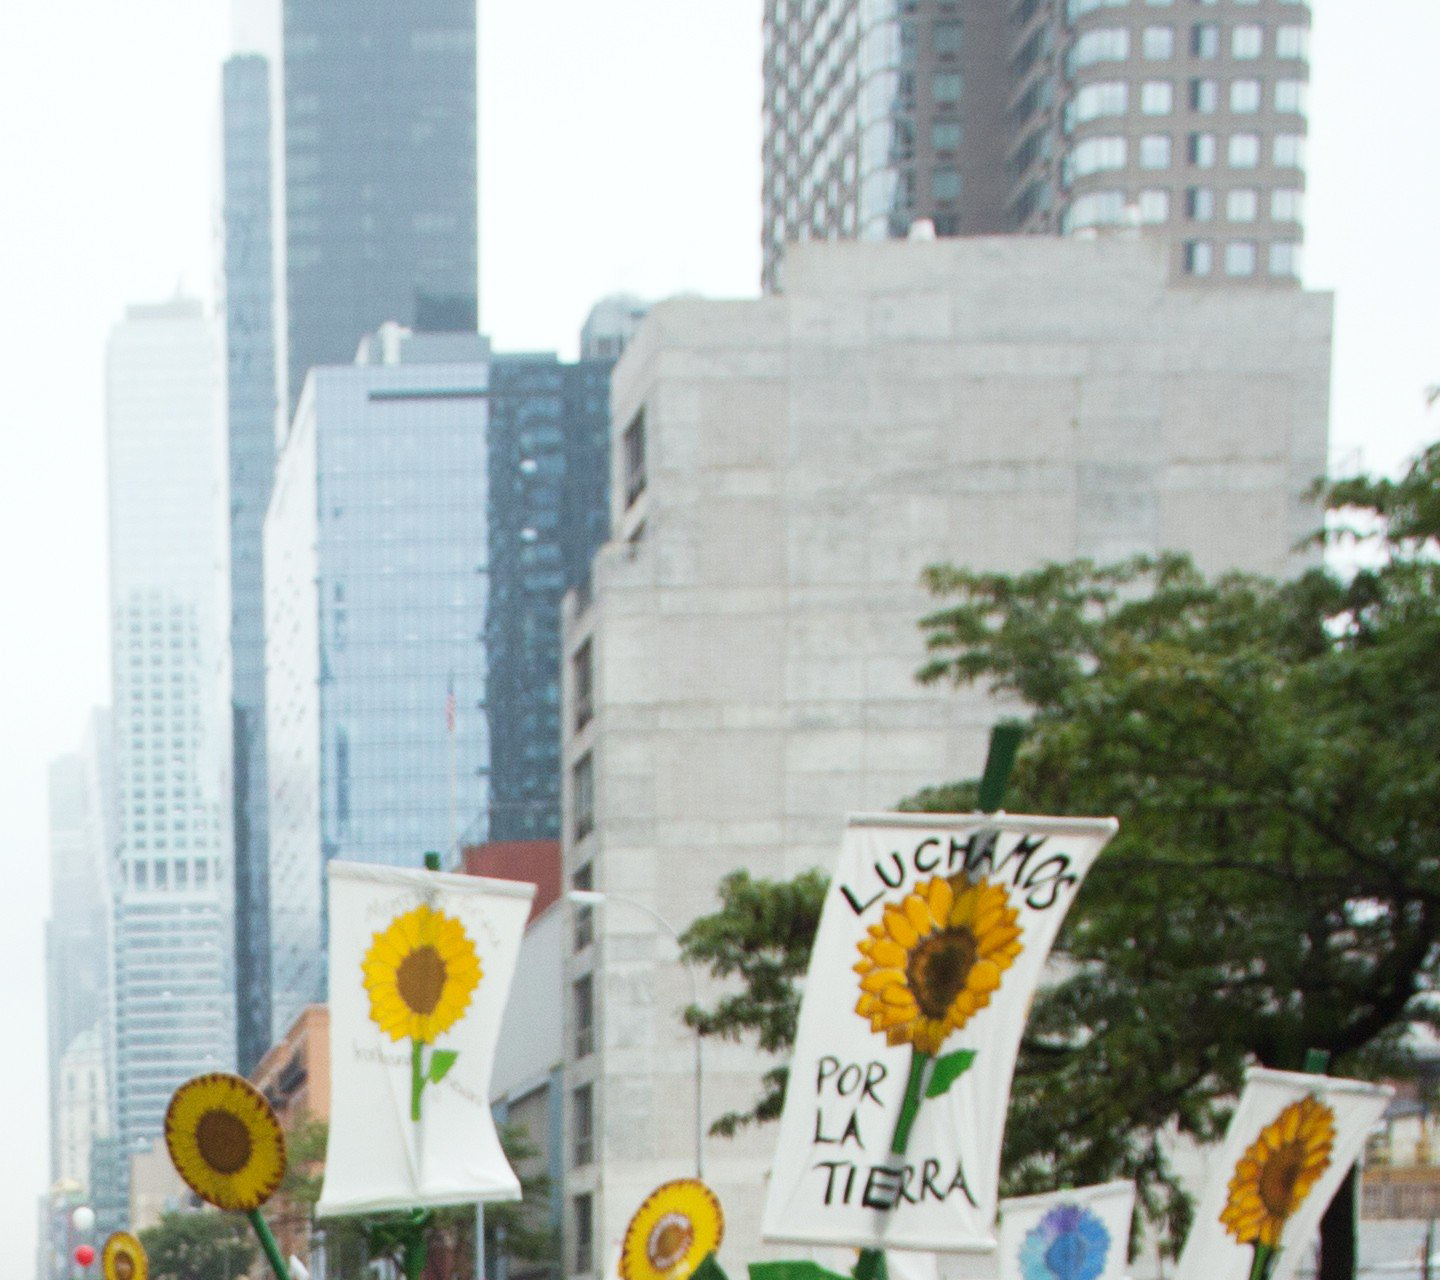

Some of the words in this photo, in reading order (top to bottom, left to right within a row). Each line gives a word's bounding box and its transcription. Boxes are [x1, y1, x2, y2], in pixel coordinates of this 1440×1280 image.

[840, 831, 1077, 916] LUCHAMOS
[817, 1055, 888, 1105] POR
[815, 1117, 863, 1149] LA
[813, 1159, 978, 1210] TIERRA
